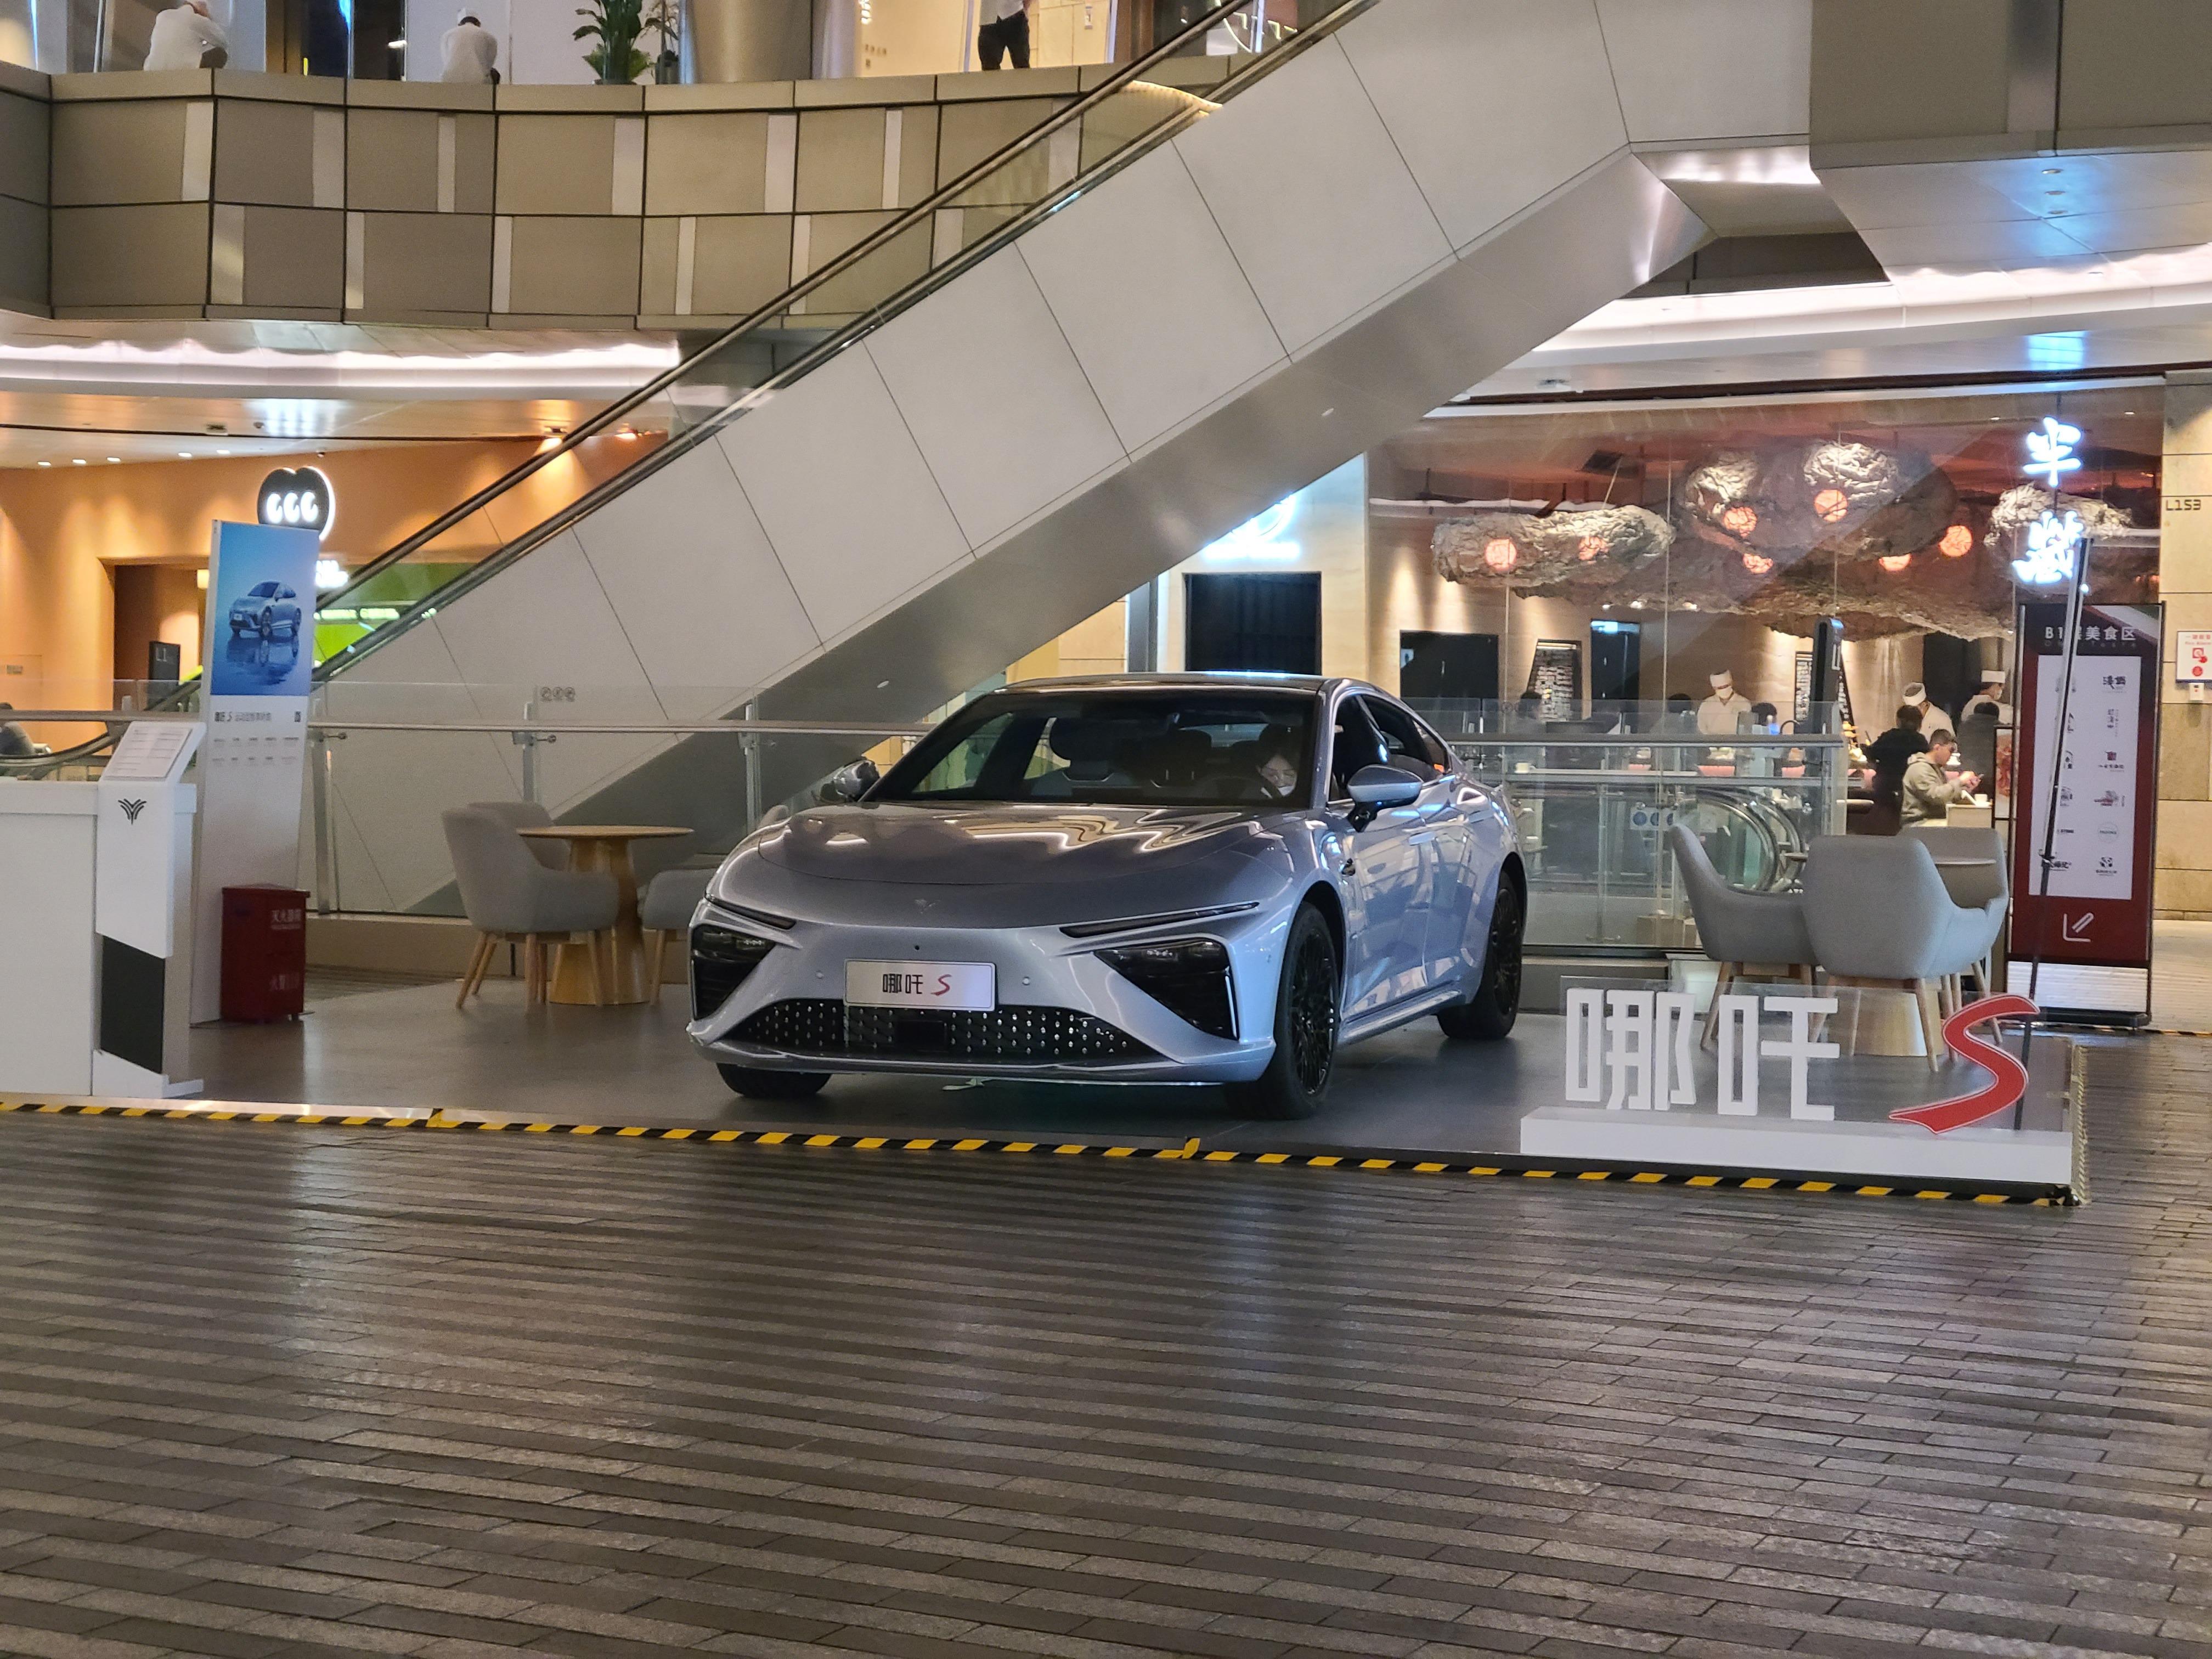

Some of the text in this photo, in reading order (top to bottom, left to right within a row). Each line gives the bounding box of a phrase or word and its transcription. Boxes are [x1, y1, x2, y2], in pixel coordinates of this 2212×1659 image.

[2165, 499, 2201, 511] L153
[2045, 625, 2136, 641] B1美食区
[882, 973, 952, 996] 哪吒 S
[1565, 988, 2041, 1135] 哪吒 S
